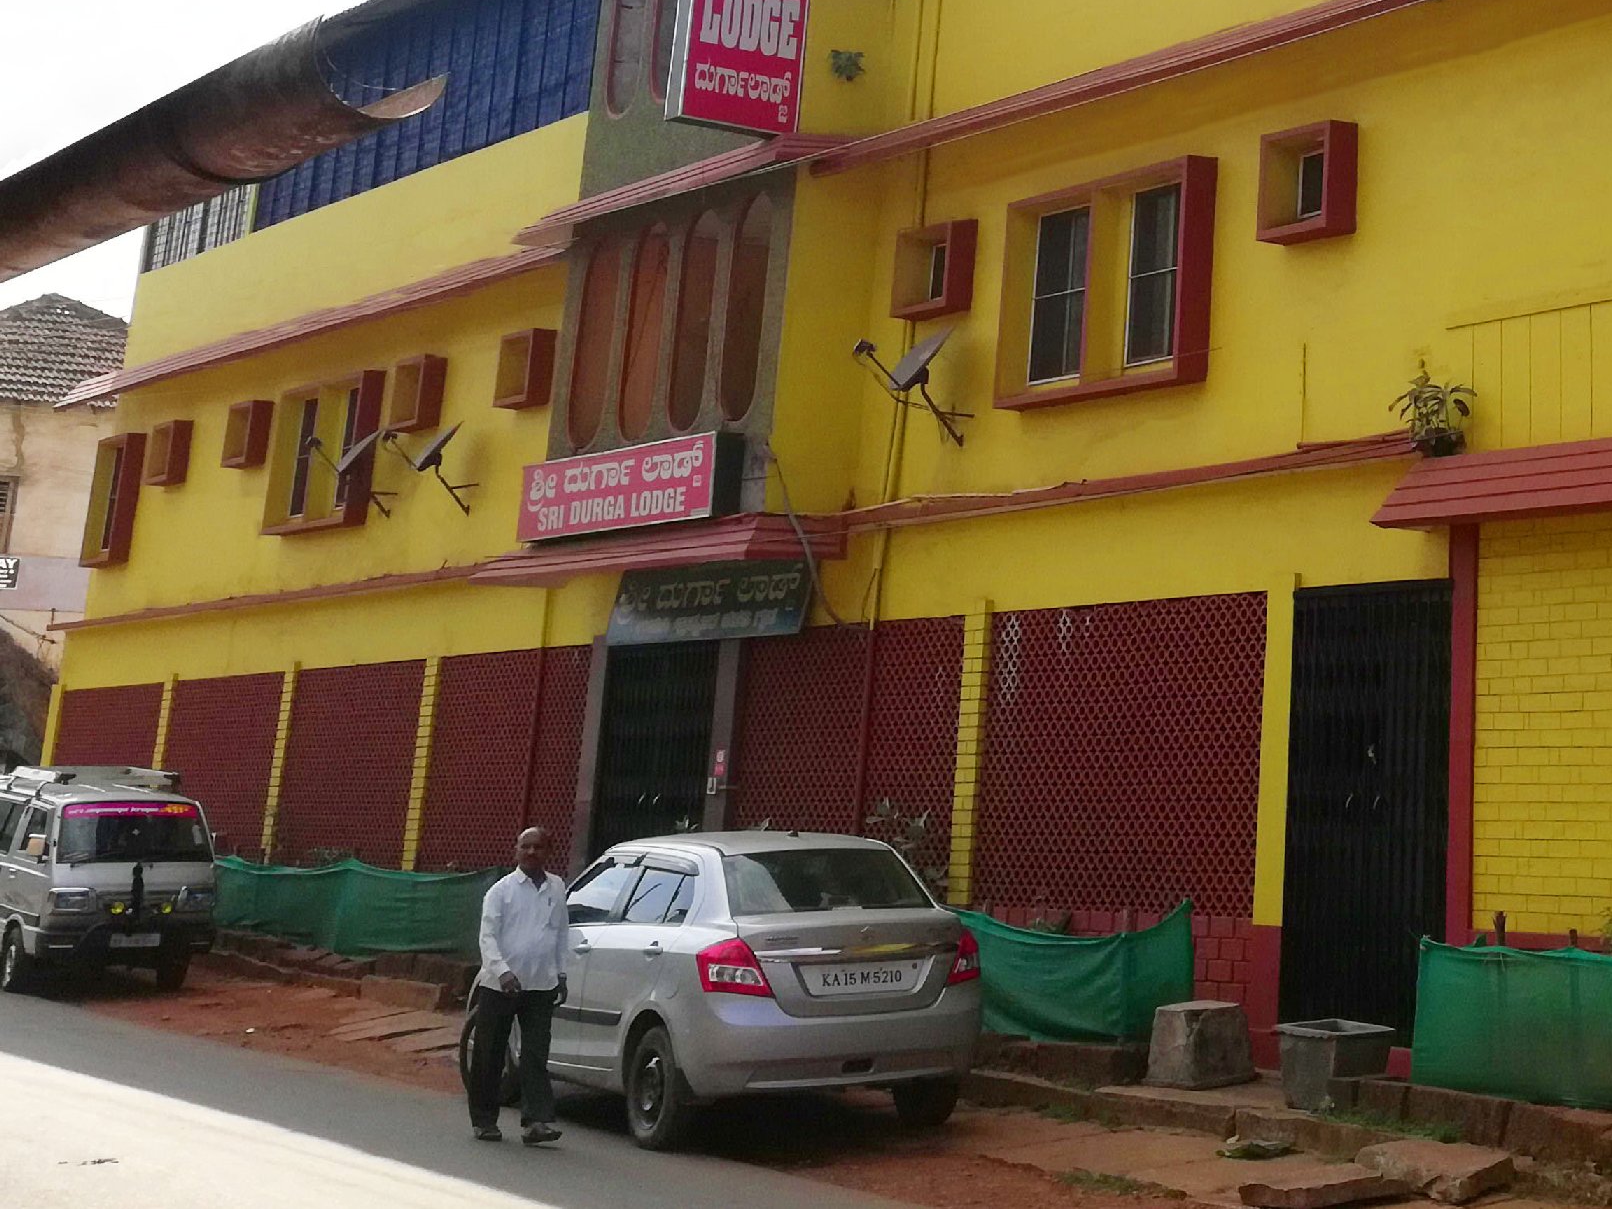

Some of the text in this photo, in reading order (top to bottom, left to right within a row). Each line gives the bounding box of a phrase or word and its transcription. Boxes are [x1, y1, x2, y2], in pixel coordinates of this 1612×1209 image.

[528, 469, 558, 512] ಶ್ರೀ
[563, 460, 635, 494] ದುರ್ಗಾ
[537, 486, 687, 532] SRI DURGA LODGE
[822, 973, 841, 987] KA
[844, 972, 857, 986] 15
